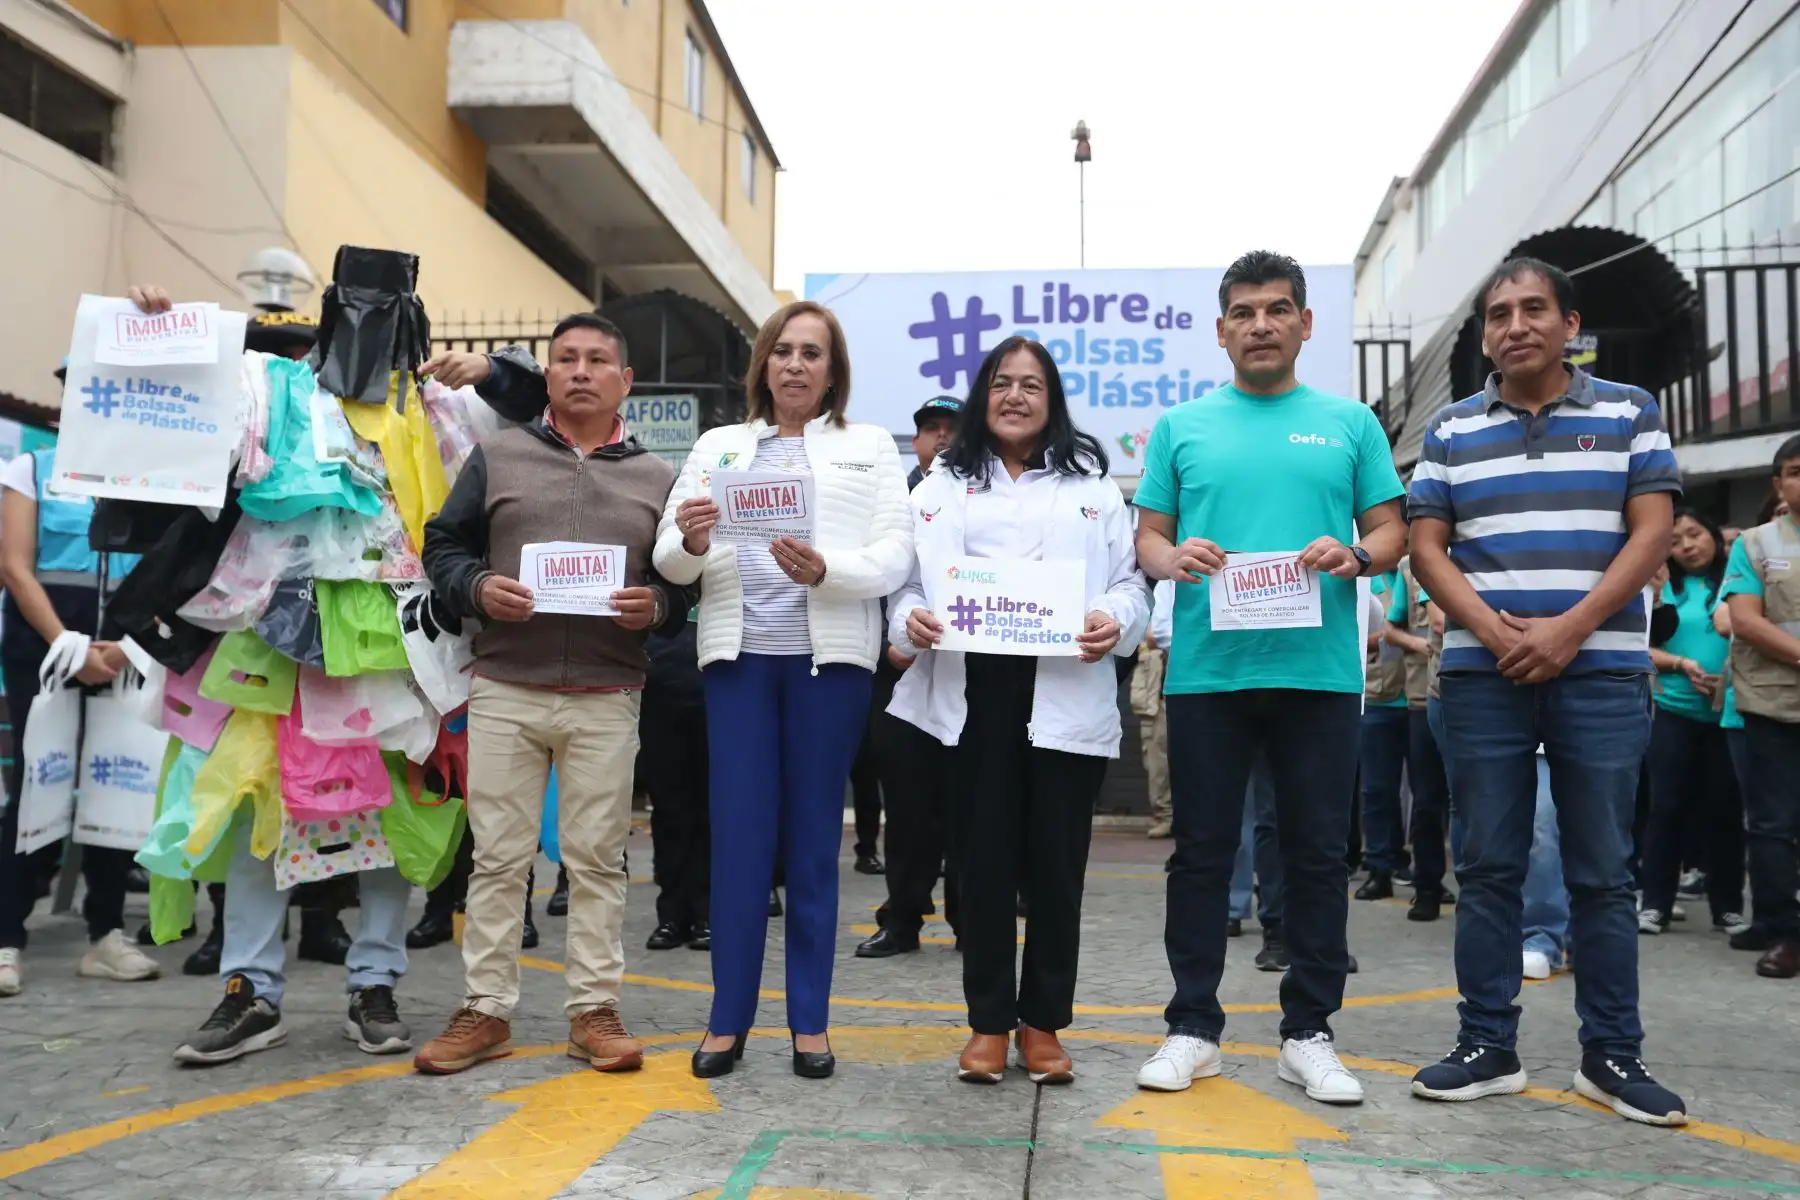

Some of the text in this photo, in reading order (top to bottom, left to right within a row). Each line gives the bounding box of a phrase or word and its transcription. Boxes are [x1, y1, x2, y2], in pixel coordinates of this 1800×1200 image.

[1012, 282, 1150, 324] Libre
[1154, 306, 1193, 329] de
[1013, 328, 1165, 365] olsas
[125, 377, 183, 398] Libre
[183, 391, 200, 403] de
[1059, 368, 1231, 408] Plástic
[122, 395, 187, 414] Bolsas
[626, 400, 692, 422] AFORO
[138, 411, 218, 434] Plástico
[1289, 433, 1326, 446] Oefa
[735, 485, 797, 510] ¡MULTA!
[736, 507, 799, 518] PREVENTIVA
[544, 555, 607, 577] ¡MULTA!
[1232, 561, 1301, 593] ¡MULTA!
[545, 575, 608, 586] PREVENTIVA
[1235, 583, 1303, 601] PREVENTIVA
[986, 596, 1038, 614] Libre
[1038, 607, 1053, 617] de
[985, 612, 1043, 629] Bolsas
[984, 626, 1072, 644] de Plástico
